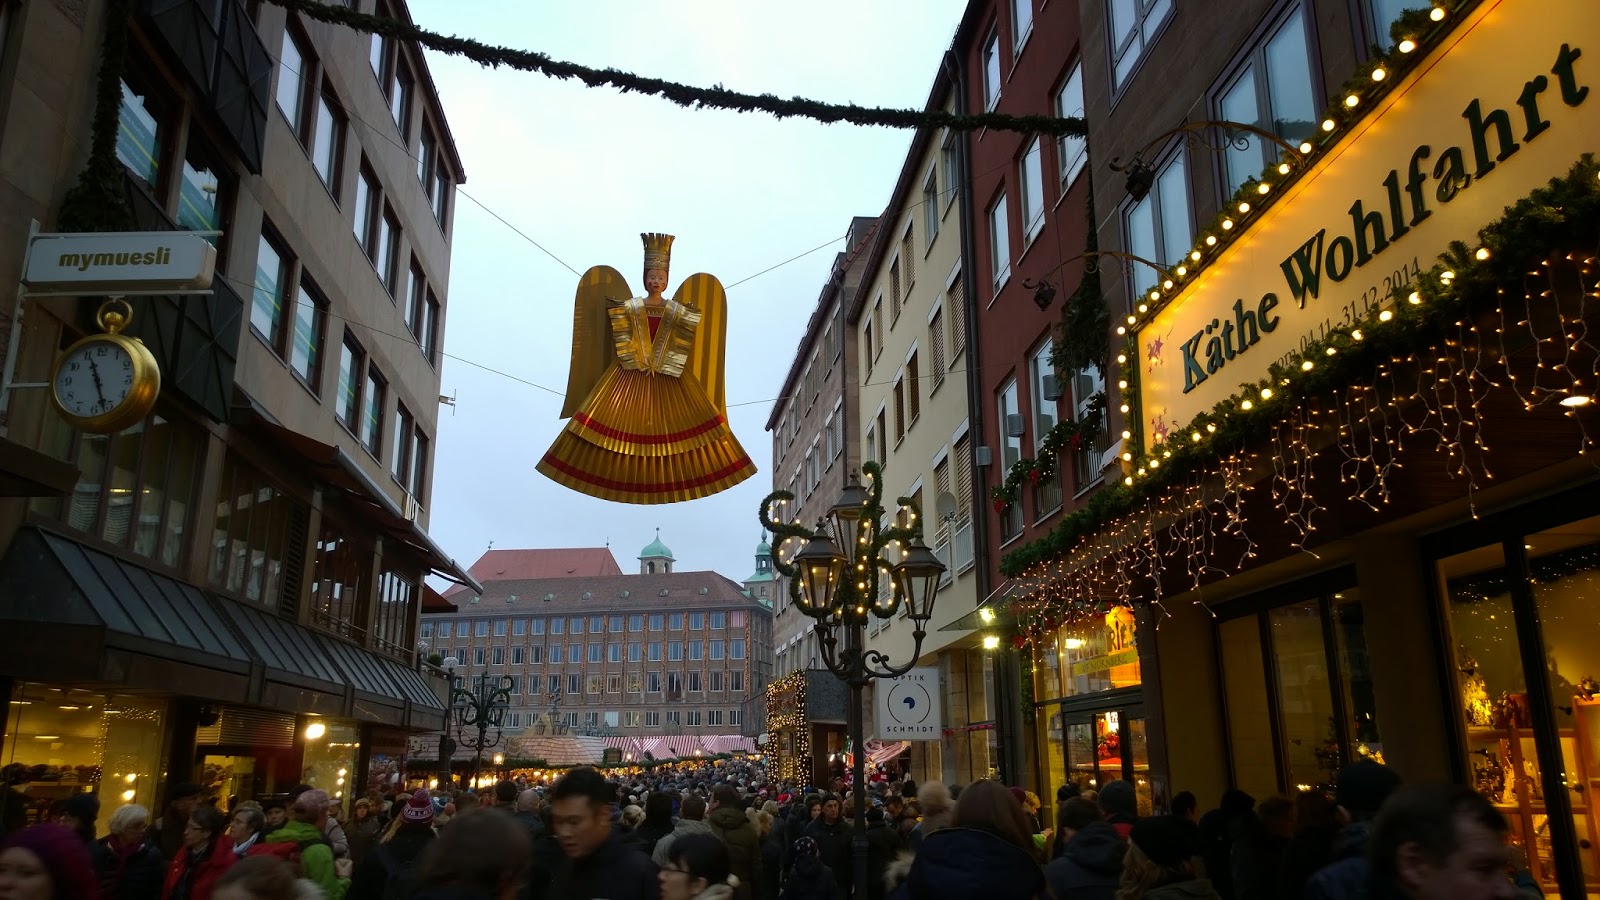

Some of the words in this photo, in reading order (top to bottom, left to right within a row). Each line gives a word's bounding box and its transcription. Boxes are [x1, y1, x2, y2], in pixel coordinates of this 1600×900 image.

[1179, 294, 1279, 394] Käthe
[1279, 43, 1590, 309] Wohlfahrt
[59, 247, 171, 272] mymuesli
[1277, 348, 1296, 368] om
[1300, 256, 1421, 352] 0411-31.12.2014
[84, 351, 92, 361] 11
[97, 347, 108, 357] 12
[115, 351, 120, 360] 1
[70, 362, 80, 371] 10
[123, 361, 131, 370] 2
[65, 376, 73, 387] 9
[125, 375, 132, 385] 3
[67, 391, 74, 401] 8
[118, 389, 126, 399] 4
[75, 401, 84, 413] 7
[90, 405, 98, 415] 6
